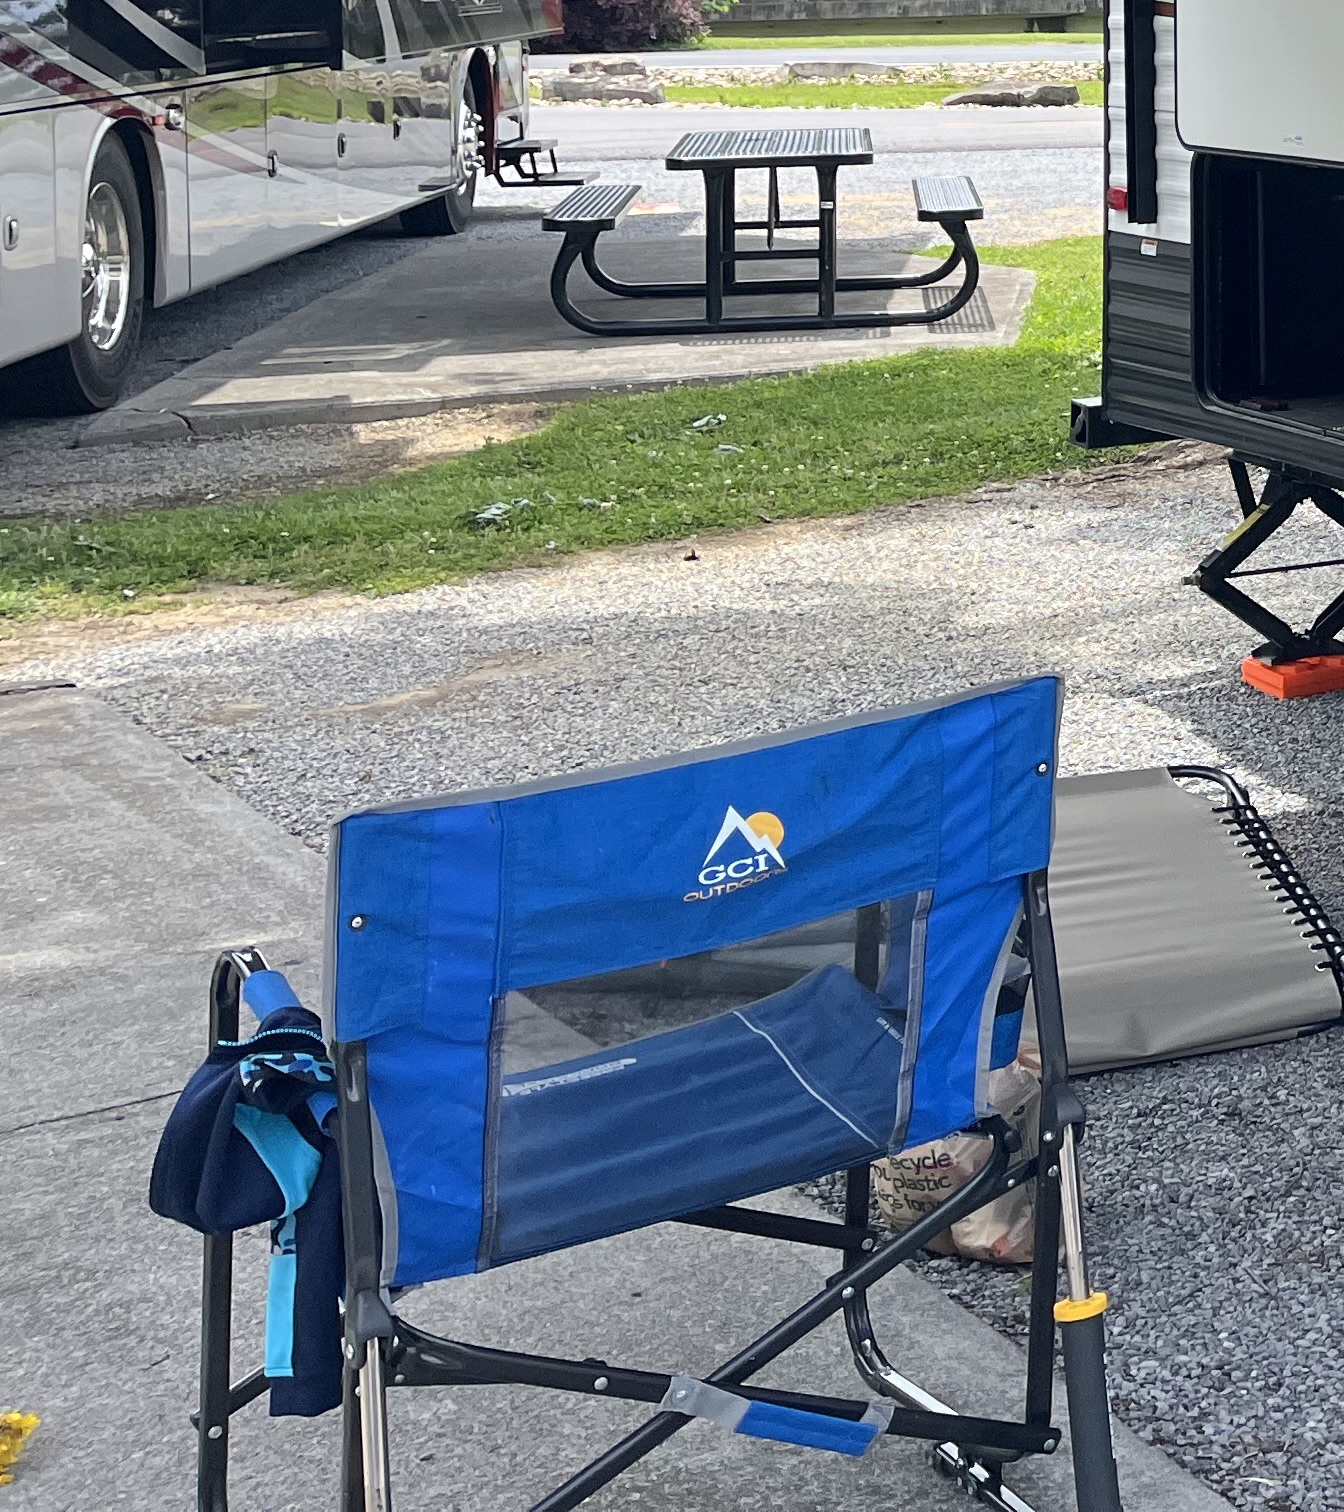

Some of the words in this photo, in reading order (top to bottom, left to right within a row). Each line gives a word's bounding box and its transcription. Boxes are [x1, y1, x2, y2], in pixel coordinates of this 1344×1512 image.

[698, 853, 770, 885] GCI
[886, 1149, 956, 1176] ecycle
[892, 1172, 953, 1194] plastic
